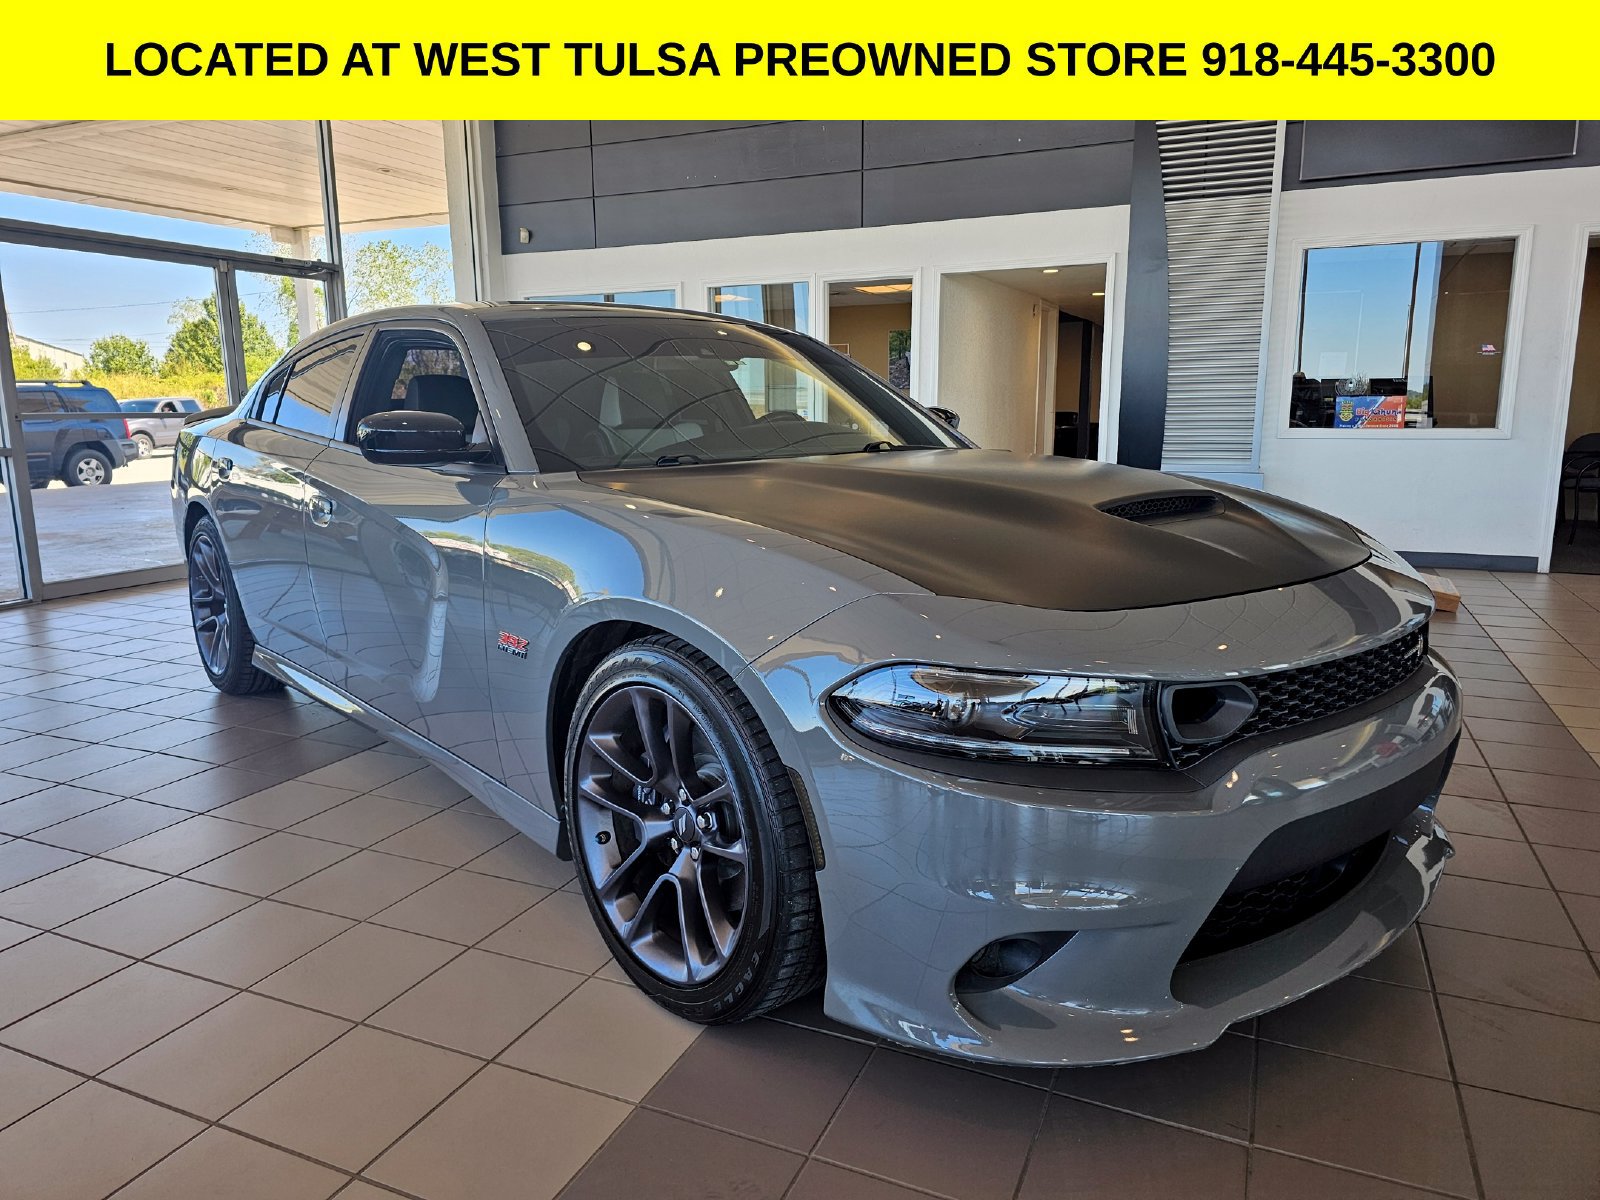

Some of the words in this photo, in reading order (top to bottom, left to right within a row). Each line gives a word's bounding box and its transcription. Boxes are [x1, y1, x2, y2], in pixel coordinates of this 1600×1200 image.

[1355, 407, 1369, 417] Big
[498, 630, 529, 652] 392
[497, 644, 528, 660] HEMI
[713, 949, 760, 1013] EAGLE
